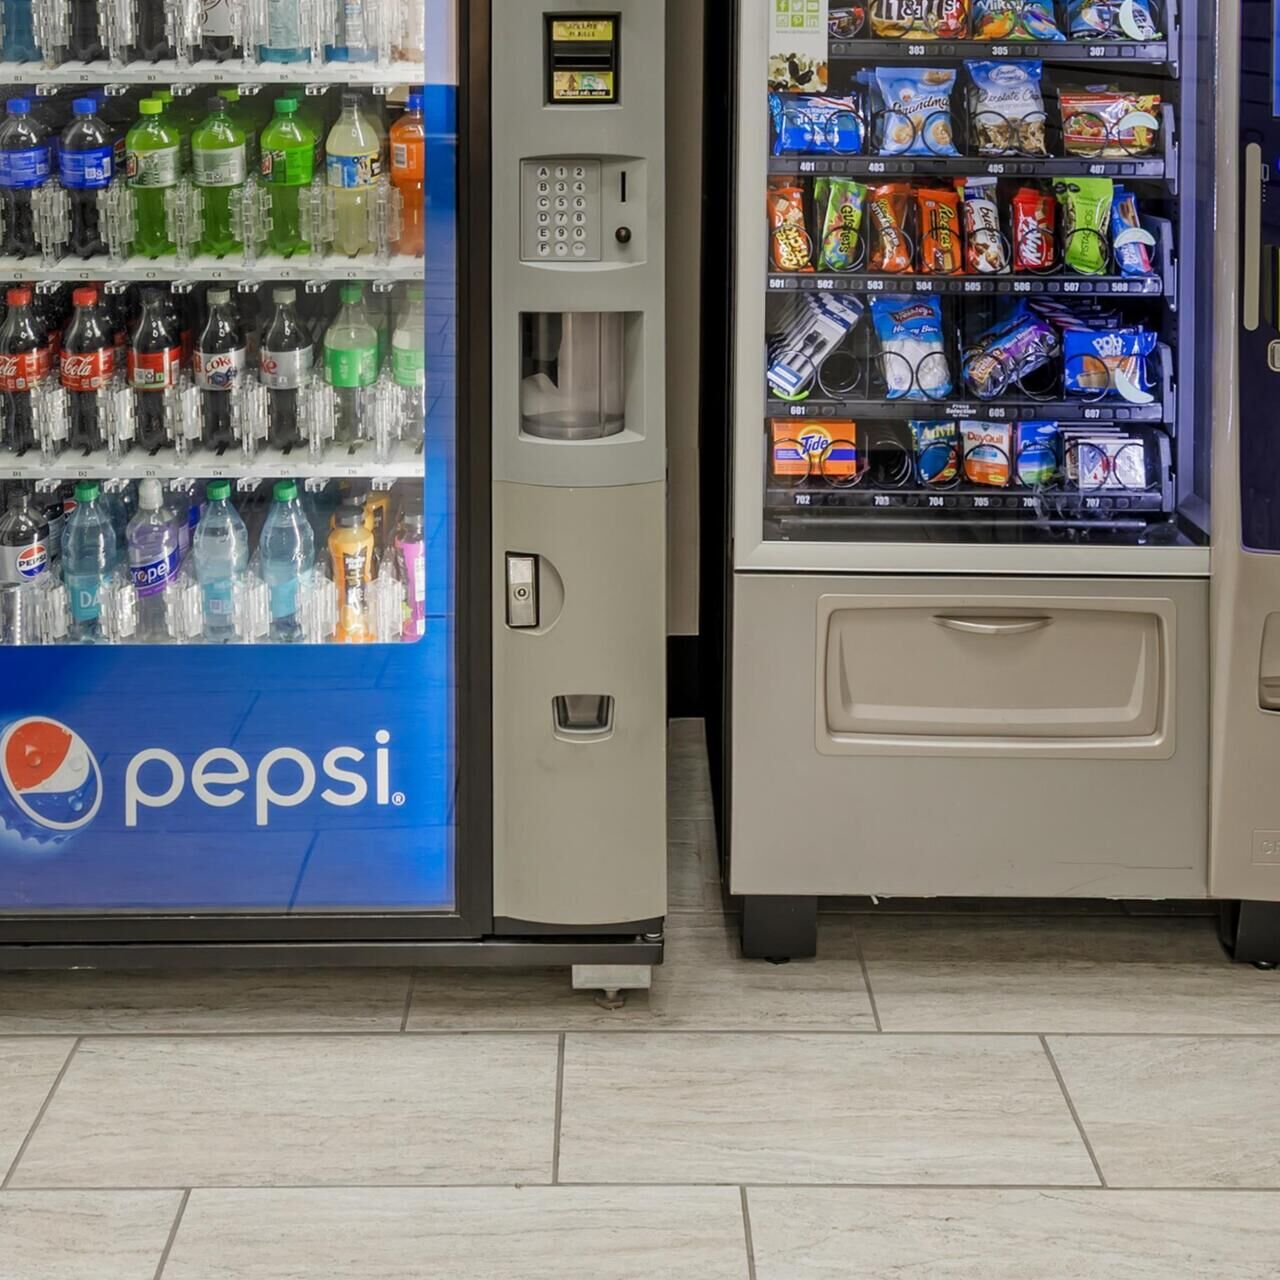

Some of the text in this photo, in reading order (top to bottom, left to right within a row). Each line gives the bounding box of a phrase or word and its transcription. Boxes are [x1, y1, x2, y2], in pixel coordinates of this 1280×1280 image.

[908, 46, 1105, 56] 303 305 307
[800, 162, 1105, 174] 401 403 405 407
[938, 202, 955, 251] Reese's
[770, 279, 1128, 291] 501 502 503 504 505 506 507 508
[64, 355, 92, 376] Cola
[790, 406, 1100, 418] 601 605 607
[921, 422, 956, 439] Advil
[967, 431, 1004, 444] DayQuil
[800, 435, 829, 455] Tide
[795, 495, 1100, 507] 702 703 704 705 707
[19, 554, 47, 568] PEPSI
[133, 562, 170, 584] ropel
[124, 729, 391, 827] pepsi
